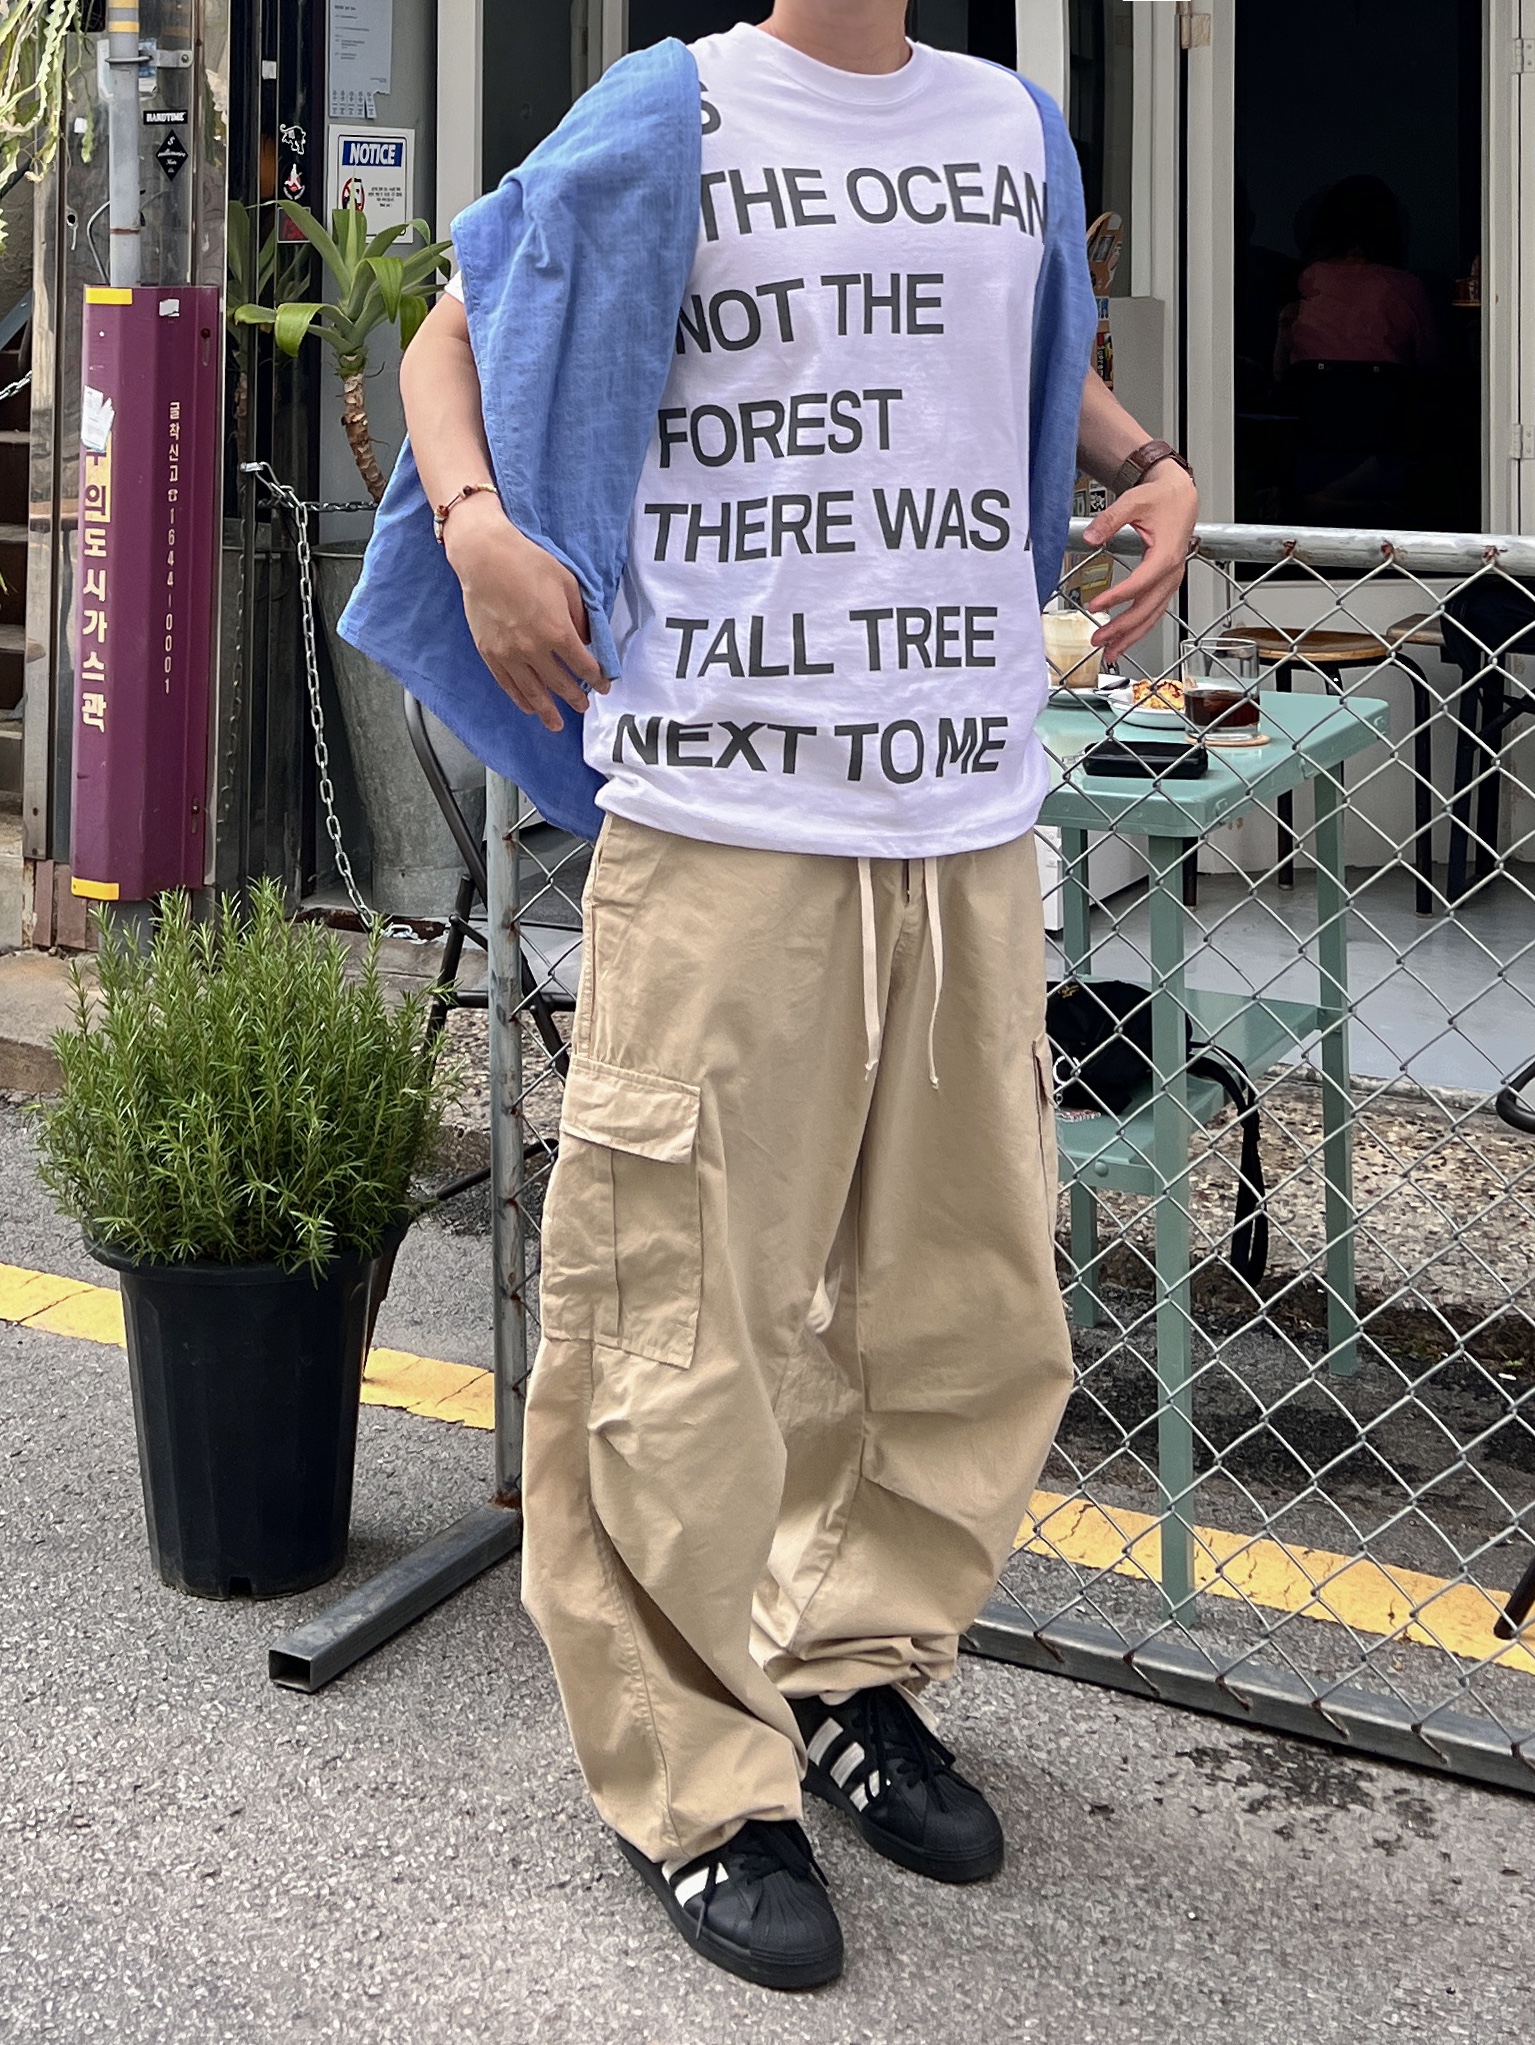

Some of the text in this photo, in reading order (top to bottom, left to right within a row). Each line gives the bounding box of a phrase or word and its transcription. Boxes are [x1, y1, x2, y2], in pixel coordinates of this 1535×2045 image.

[349, 142, 397, 166] NOTICE
[701, 162, 1047, 242] THE OCEAN
[676, 273, 944, 355] NOT THE
[657, 388, 903, 469] FOREST
[644, 488, 1010, 563] THERE WAS
[81, 528, 108, 733] 도시가스관
[665, 606, 998, 679] TALL TREE
[612, 714, 1009, 785] NEXT TO ME
